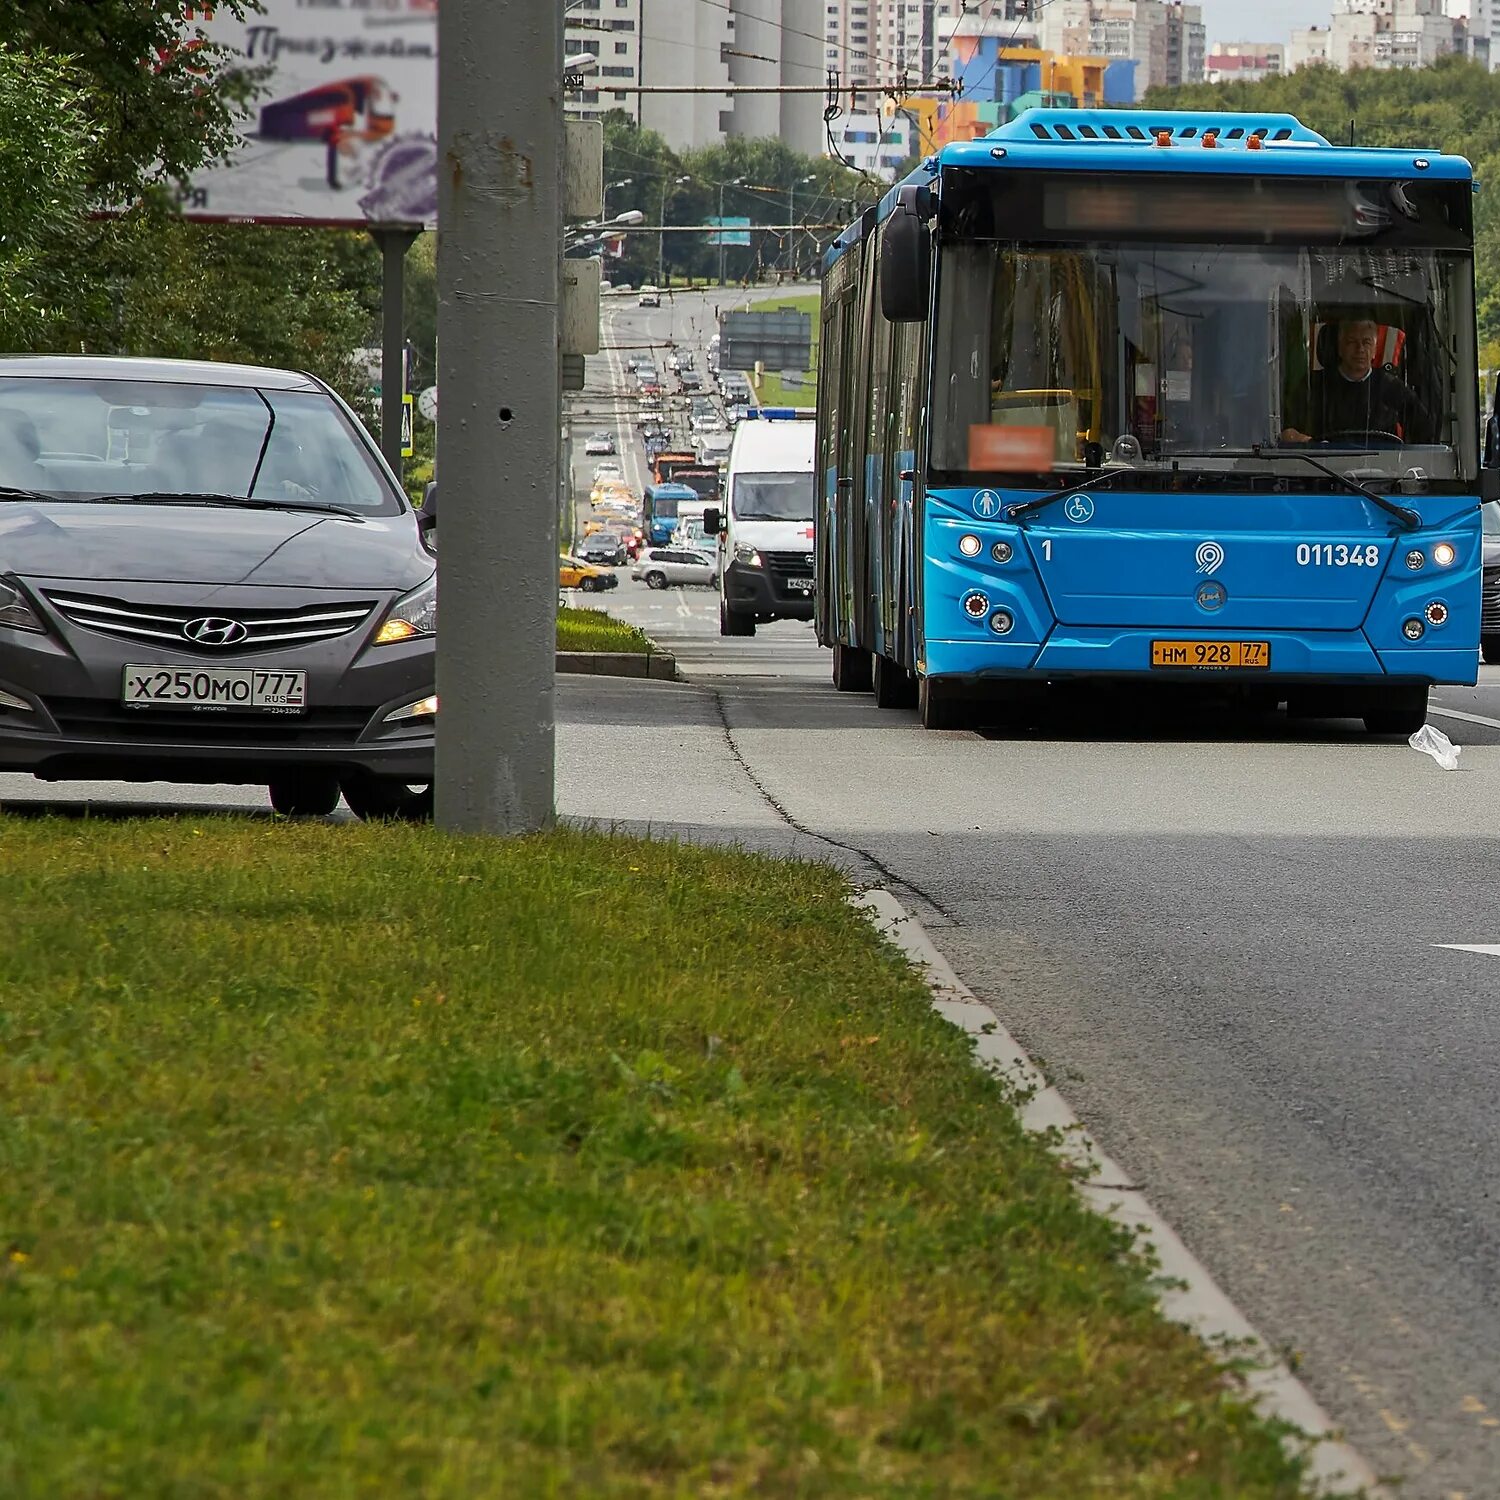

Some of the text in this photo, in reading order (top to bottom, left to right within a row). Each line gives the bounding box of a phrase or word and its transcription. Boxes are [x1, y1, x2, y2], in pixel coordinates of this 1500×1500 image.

[1042, 539, 1051, 561] 1
[1296, 543, 1379, 567] 011348
[1194, 644, 1231, 663] 928
[1242, 644, 1262, 659] 77
[255, 673, 299, 695] 777
[264, 695, 286, 704] RUS
